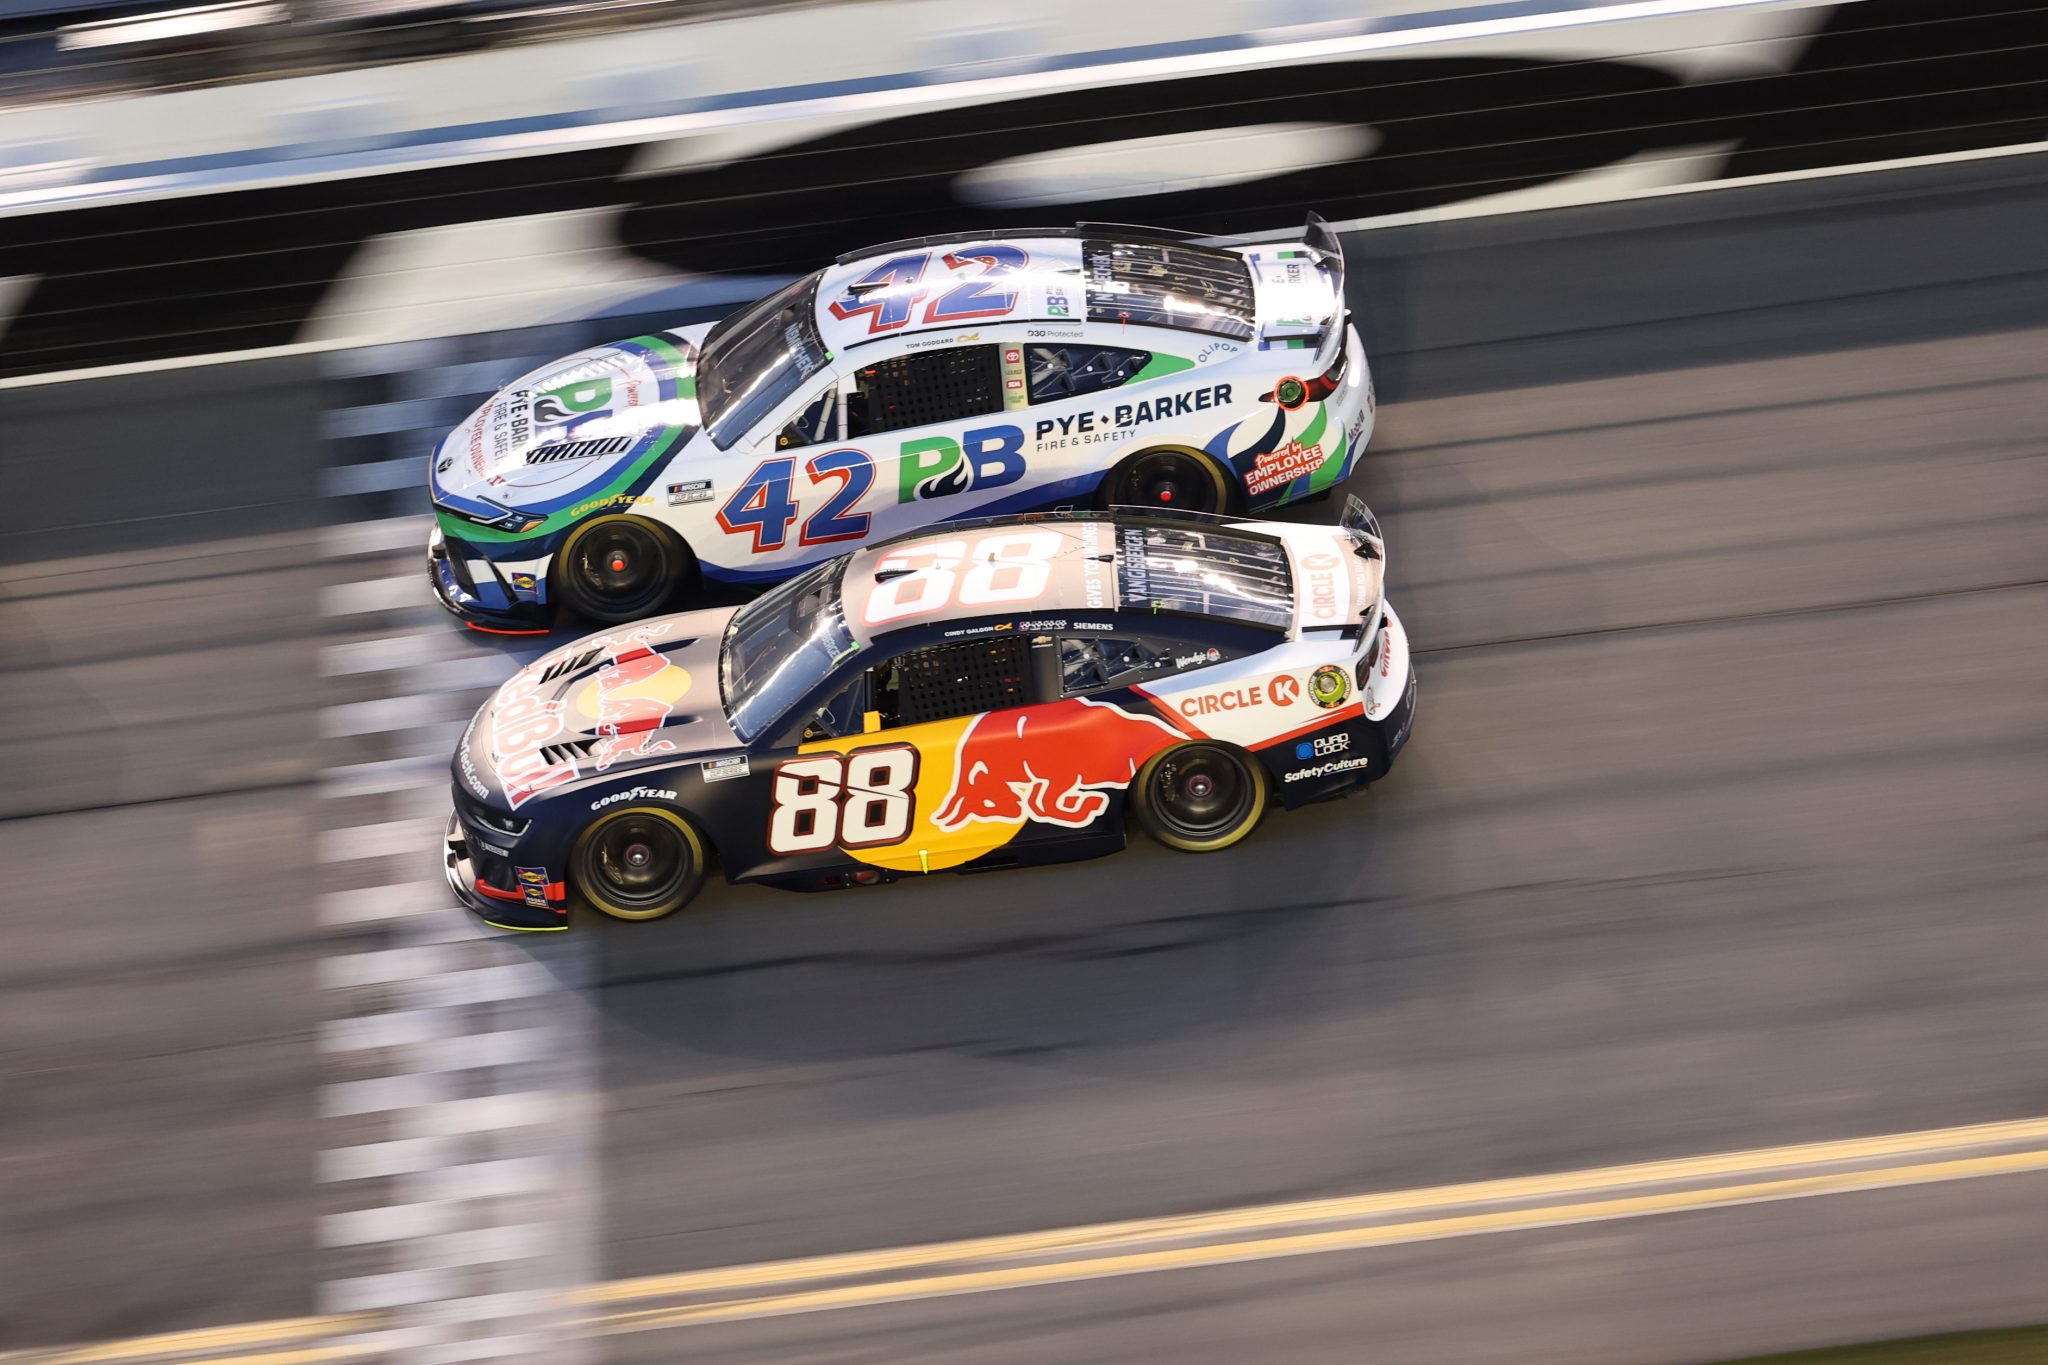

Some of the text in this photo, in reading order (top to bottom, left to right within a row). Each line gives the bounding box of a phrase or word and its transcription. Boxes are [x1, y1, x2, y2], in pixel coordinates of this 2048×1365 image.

[828, 244, 1030, 334] 42
[922, 338, 954, 347] GODDARD
[1199, 342, 1239, 363] OLIPOP
[1036, 383, 1233, 441] PYE BARKER
[1037, 429, 1137, 452] FIRE & SAFETY
[1246, 445, 1322, 484] EMPLOYEE
[1256, 445, 1290, 468] Powered
[1249, 458, 1325, 495] OWNERSHIP
[570, 493, 655, 516] GOODYEAR
[715, 448, 877, 553] 42
[863, 531, 1064, 623] 88
[1086, 579, 1103, 608] GIVES
[1311, 573, 1336, 619] CIRCLE
[1073, 622, 1113, 630] SIEMENS
[1175, 652, 1206, 668] Wendy's
[1181, 686, 1263, 717] CIRCLE
[1314, 733, 1349, 748] QUAD
[1315, 742, 1350, 757] LOCK
[1284, 757, 1369, 783] SafetyCulture
[591, 786, 677, 810] GOODYEAR
[767, 741, 921, 856] 88
